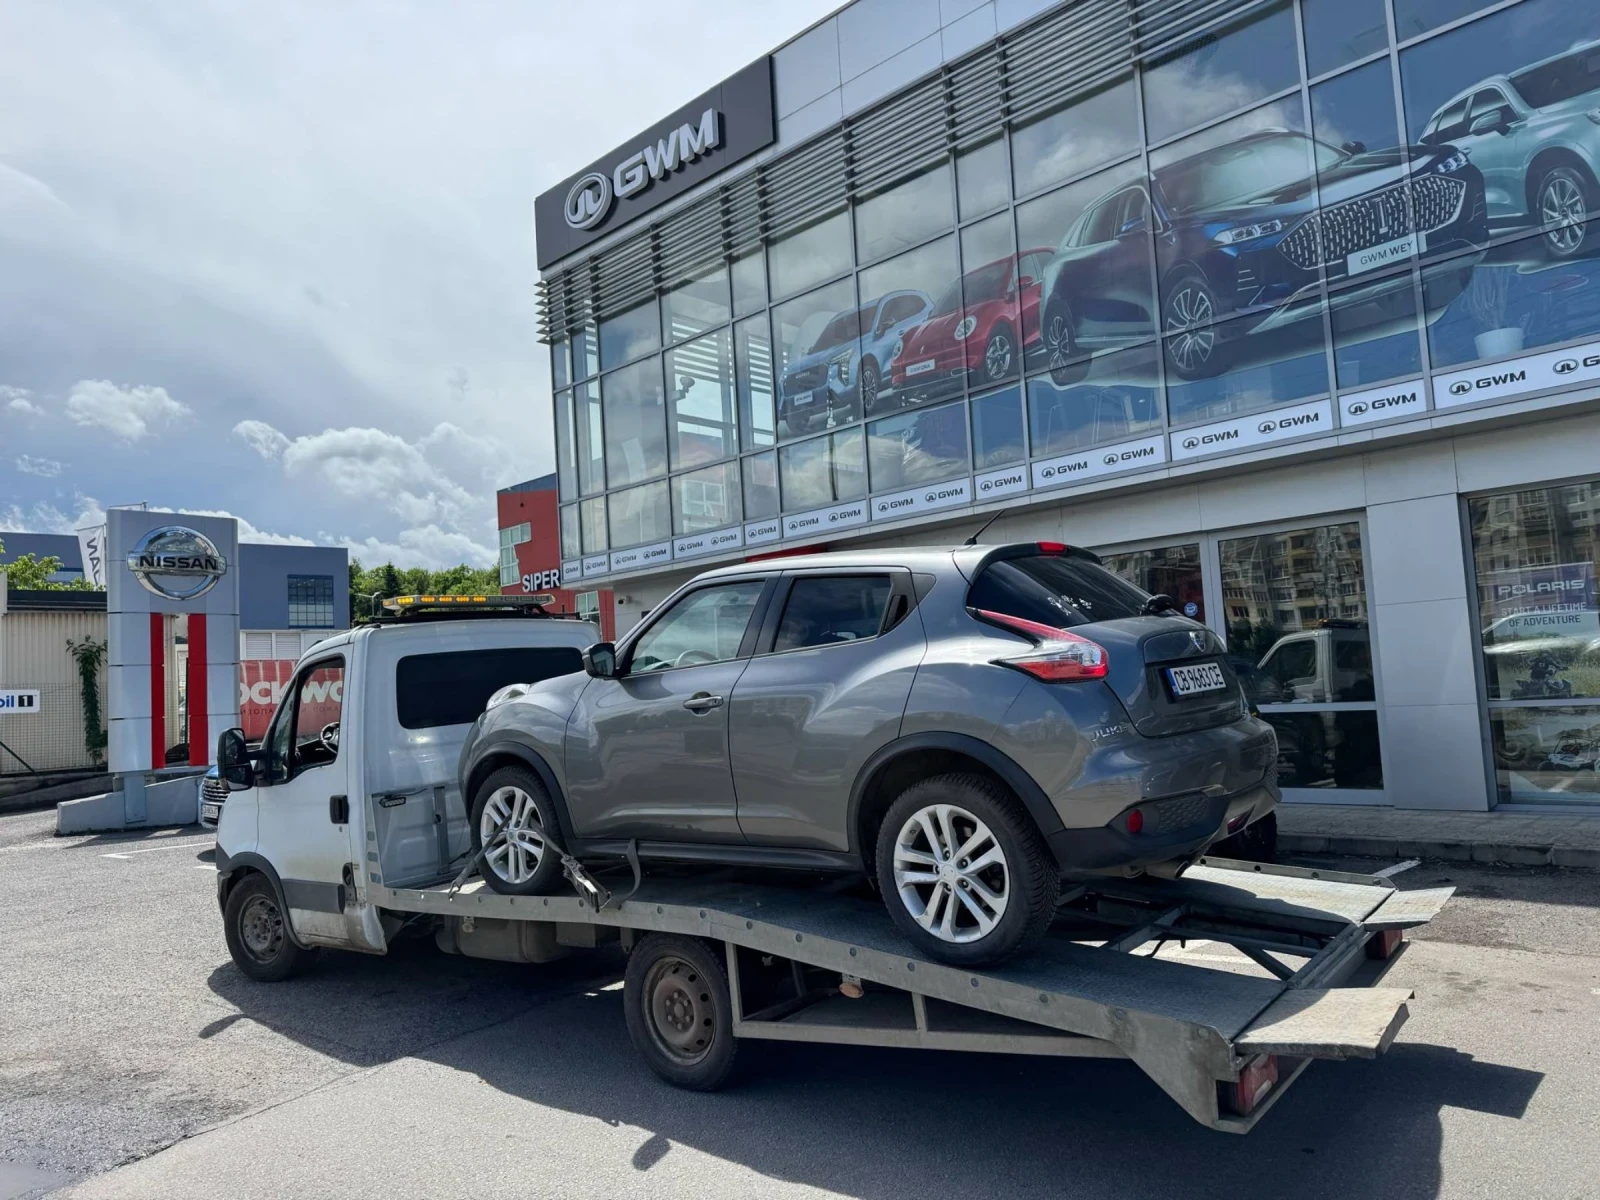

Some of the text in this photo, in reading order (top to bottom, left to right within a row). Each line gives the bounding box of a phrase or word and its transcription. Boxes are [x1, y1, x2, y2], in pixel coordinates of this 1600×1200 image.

[613, 108, 720, 198] GWM
[1360, 240, 1413, 265] GWM WEY
[1475, 370, 1527, 389] GWM
[1371, 392, 1417, 411] GWM
[1279, 412, 1320, 429] GWM
[1201, 429, 1239, 445] GWM
[1121, 447, 1154, 461] GWM
[1057, 461, 1088, 474] GWM
[994, 475, 1022, 488] GWM
[938, 488, 964, 499] GWM
[890, 498, 914, 509] GWM
[839, 509, 861, 519] GWM
[799, 517, 819, 527] GWM
[757, 526, 777, 536] GWM
[719, 534, 737, 543] GWM
[686, 541, 703, 550] GWM
[621, 554, 637, 563] GWM
[651, 549, 667, 558] GWM
[139, 555, 217, 570] NISSAN
[522, 568, 560, 593] SIPER
[1498, 579, 1585, 596] POLARIS
[1501, 602, 1587, 616] START A LIFETIME
[1508, 614, 1581, 627] OF ADVENTURE
